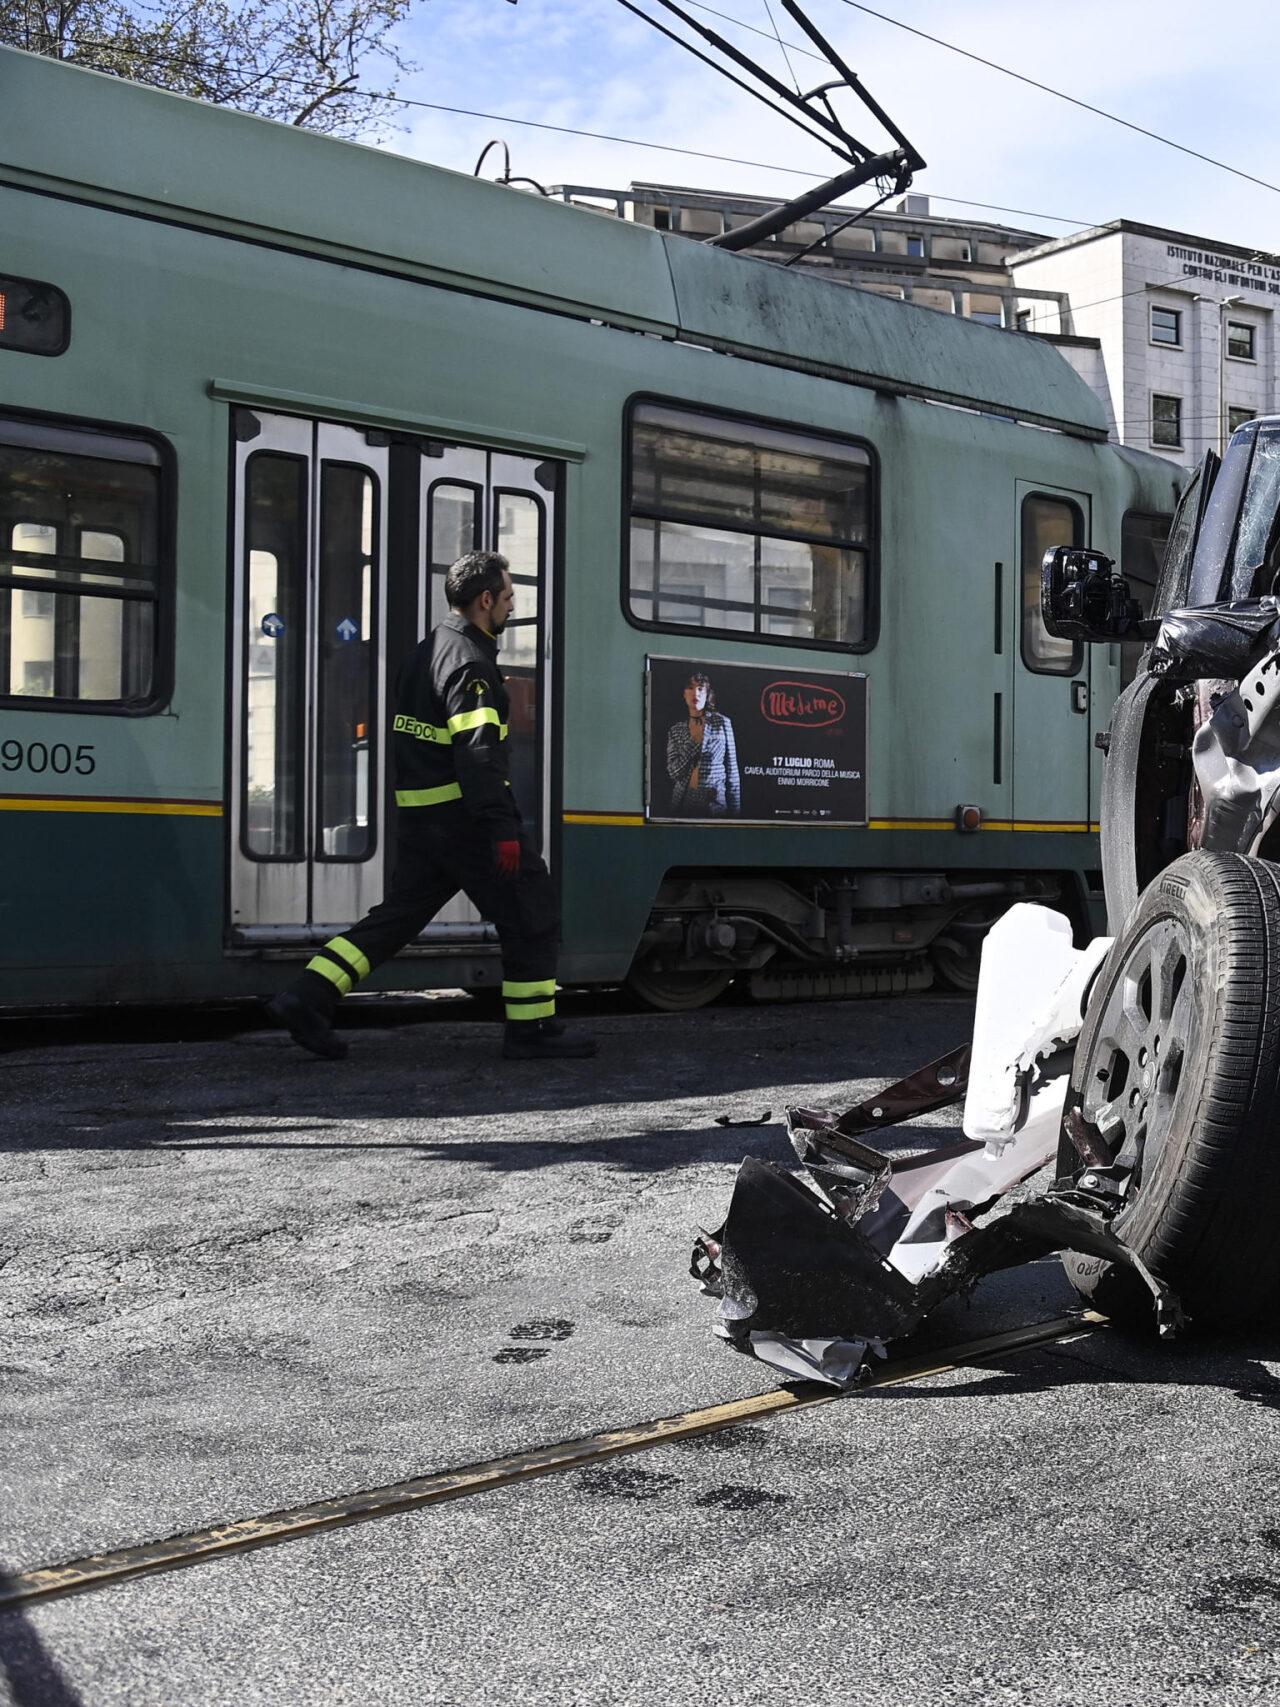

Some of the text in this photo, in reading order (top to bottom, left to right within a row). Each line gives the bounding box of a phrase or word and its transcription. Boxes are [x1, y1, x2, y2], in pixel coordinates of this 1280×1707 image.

[1167, 245, 1203, 263] ISTITUTO
[1204, 255, 1245, 273] NAZIONALE
[1247, 263, 1262, 277] PER
[1183, 264, 1213, 280] CONTRO
[1214, 270, 1227, 283] GLI
[1228, 273, 1266, 292] INFORTUNI
[1268, 282, 1280, 296] SUL
[769, 691, 837, 716] Madame
[1, 740, 96, 775] 9005
[773, 757, 835, 769] 17 LUGLIO ROMA
[744, 766, 861, 779] CAVEA, AUDITORIUM PARCO DELLA MUSICA
[777, 777, 830, 787] ENNIO MORRICONE
[1077, 1260, 1105, 1276] ERO
